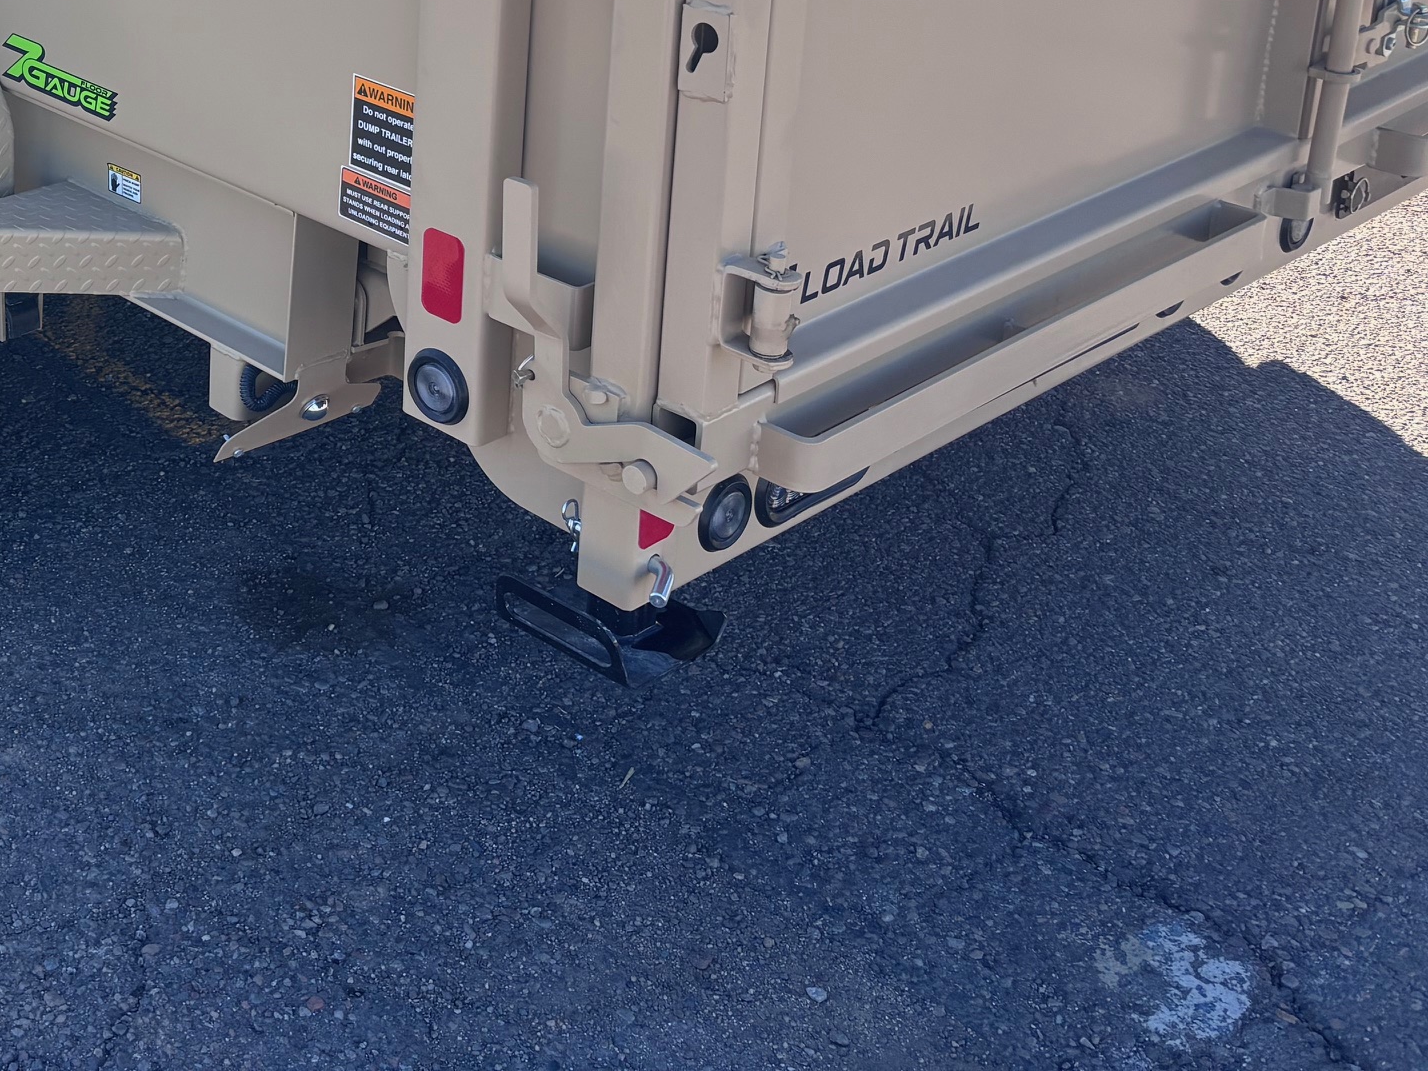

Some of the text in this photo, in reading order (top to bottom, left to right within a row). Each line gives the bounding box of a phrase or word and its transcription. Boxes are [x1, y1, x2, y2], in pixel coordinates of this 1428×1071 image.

[2, 33, 118, 121] 7 GAUGE
[363, 106, 373, 116] Do
[374, 112, 386, 120] not
[358, 120, 380, 134] DUMP
[358, 138, 372, 148] with
[374, 144, 386, 154] out
[353, 152, 383, 171] securing
[384, 164, 399, 176] rear
[346, 188, 361, 199] MUST
[362, 194, 372, 204] USE
[374, 200, 388, 210] REAR
[362, 178, 398, 201] WARNING
[343, 196, 363, 210] STANDS
[364, 206, 380, 217] WHEN
[380, 213, 404, 228] LOADING
[348, 208, 378, 226] UNLOADING
[800, 203, 980, 304] LOAD TRAIL
